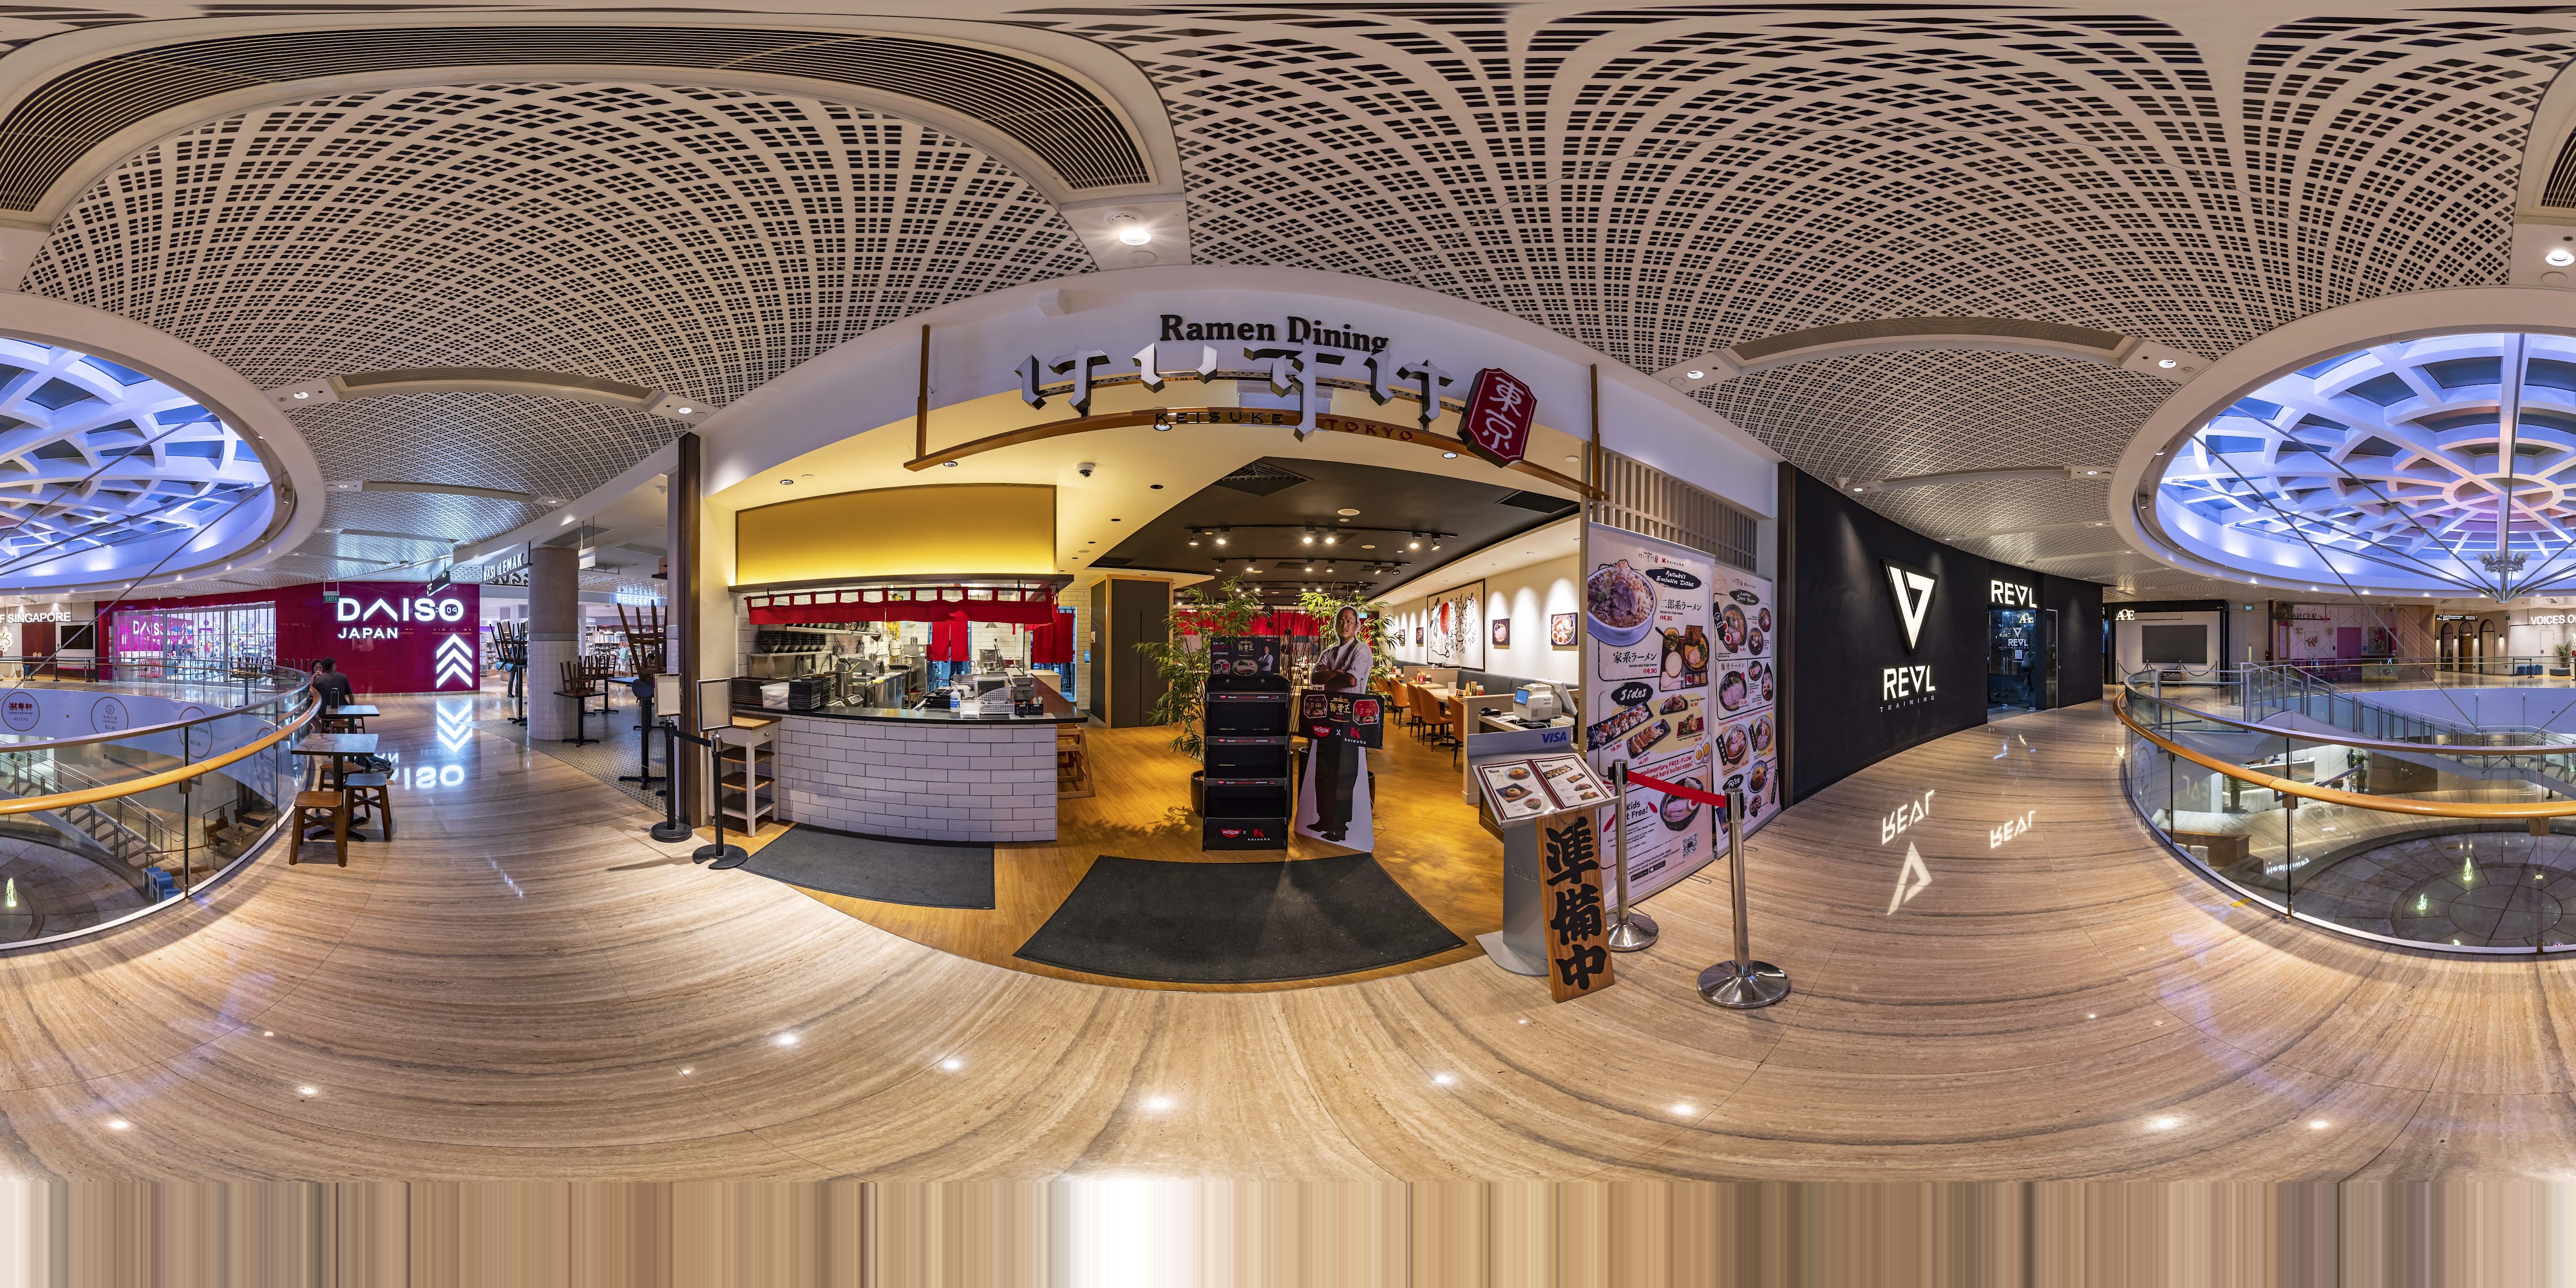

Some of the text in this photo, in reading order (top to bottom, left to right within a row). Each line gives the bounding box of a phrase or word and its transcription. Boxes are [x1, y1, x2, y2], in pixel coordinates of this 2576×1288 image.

[1160, 314, 1389, 354] Ramen Dining
[1155, 412, 1283, 424] KEISUKE
[1481, 375, 1525, 450] 東京
[1326, 419, 1413, 441] TOKYO
[483, 565, 495, 582] NASI
[499, 553, 522, 575] LEMAK
[1656, 575, 1678, 584] Exclusive
[1665, 570, 1686, 579] Keisuke's
[618, 596, 658, 605] THREEPY
[1991, 580, 2037, 608] REVL
[337, 598, 464, 621] DAISO
[1660, 598, 1702, 611] 二郎系ラーメン
[8, 612, 71, 623] SINGAPORE
[2116, 609, 2135, 621] AOE
[2530, 614, 2564, 625] VOICES
[338, 627, 398, 639] JAPAN
[2008, 638, 2028, 647] REVL
[1613, 652, 1657, 664] 家系ラーメン
[1883, 665, 1936, 701] REVL
[1620, 688, 1647, 701] Sides
[1879, 695, 1935, 713] TRAINING
[1540, 732, 1567, 744] VISA
[1611, 743, 1622, 752] $9.90
[1669, 755, 1692, 768] FREE-FLOW
[1659, 770, 1669, 779] hard
[1669, 766, 1682, 774] boiled
[1682, 761, 1693, 770] eggs!
[1727, 777, 1741, 788] Rice
[1631, 806, 1648, 819] Free!
[1651, 852, 1665, 862] Keisuke
[1629, 867, 1641, 876] points
[1649, 858, 1662, 867] redeem
[1510, 865, 1539, 884] VISA
[1546, 816, 1607, 990] 準備中
